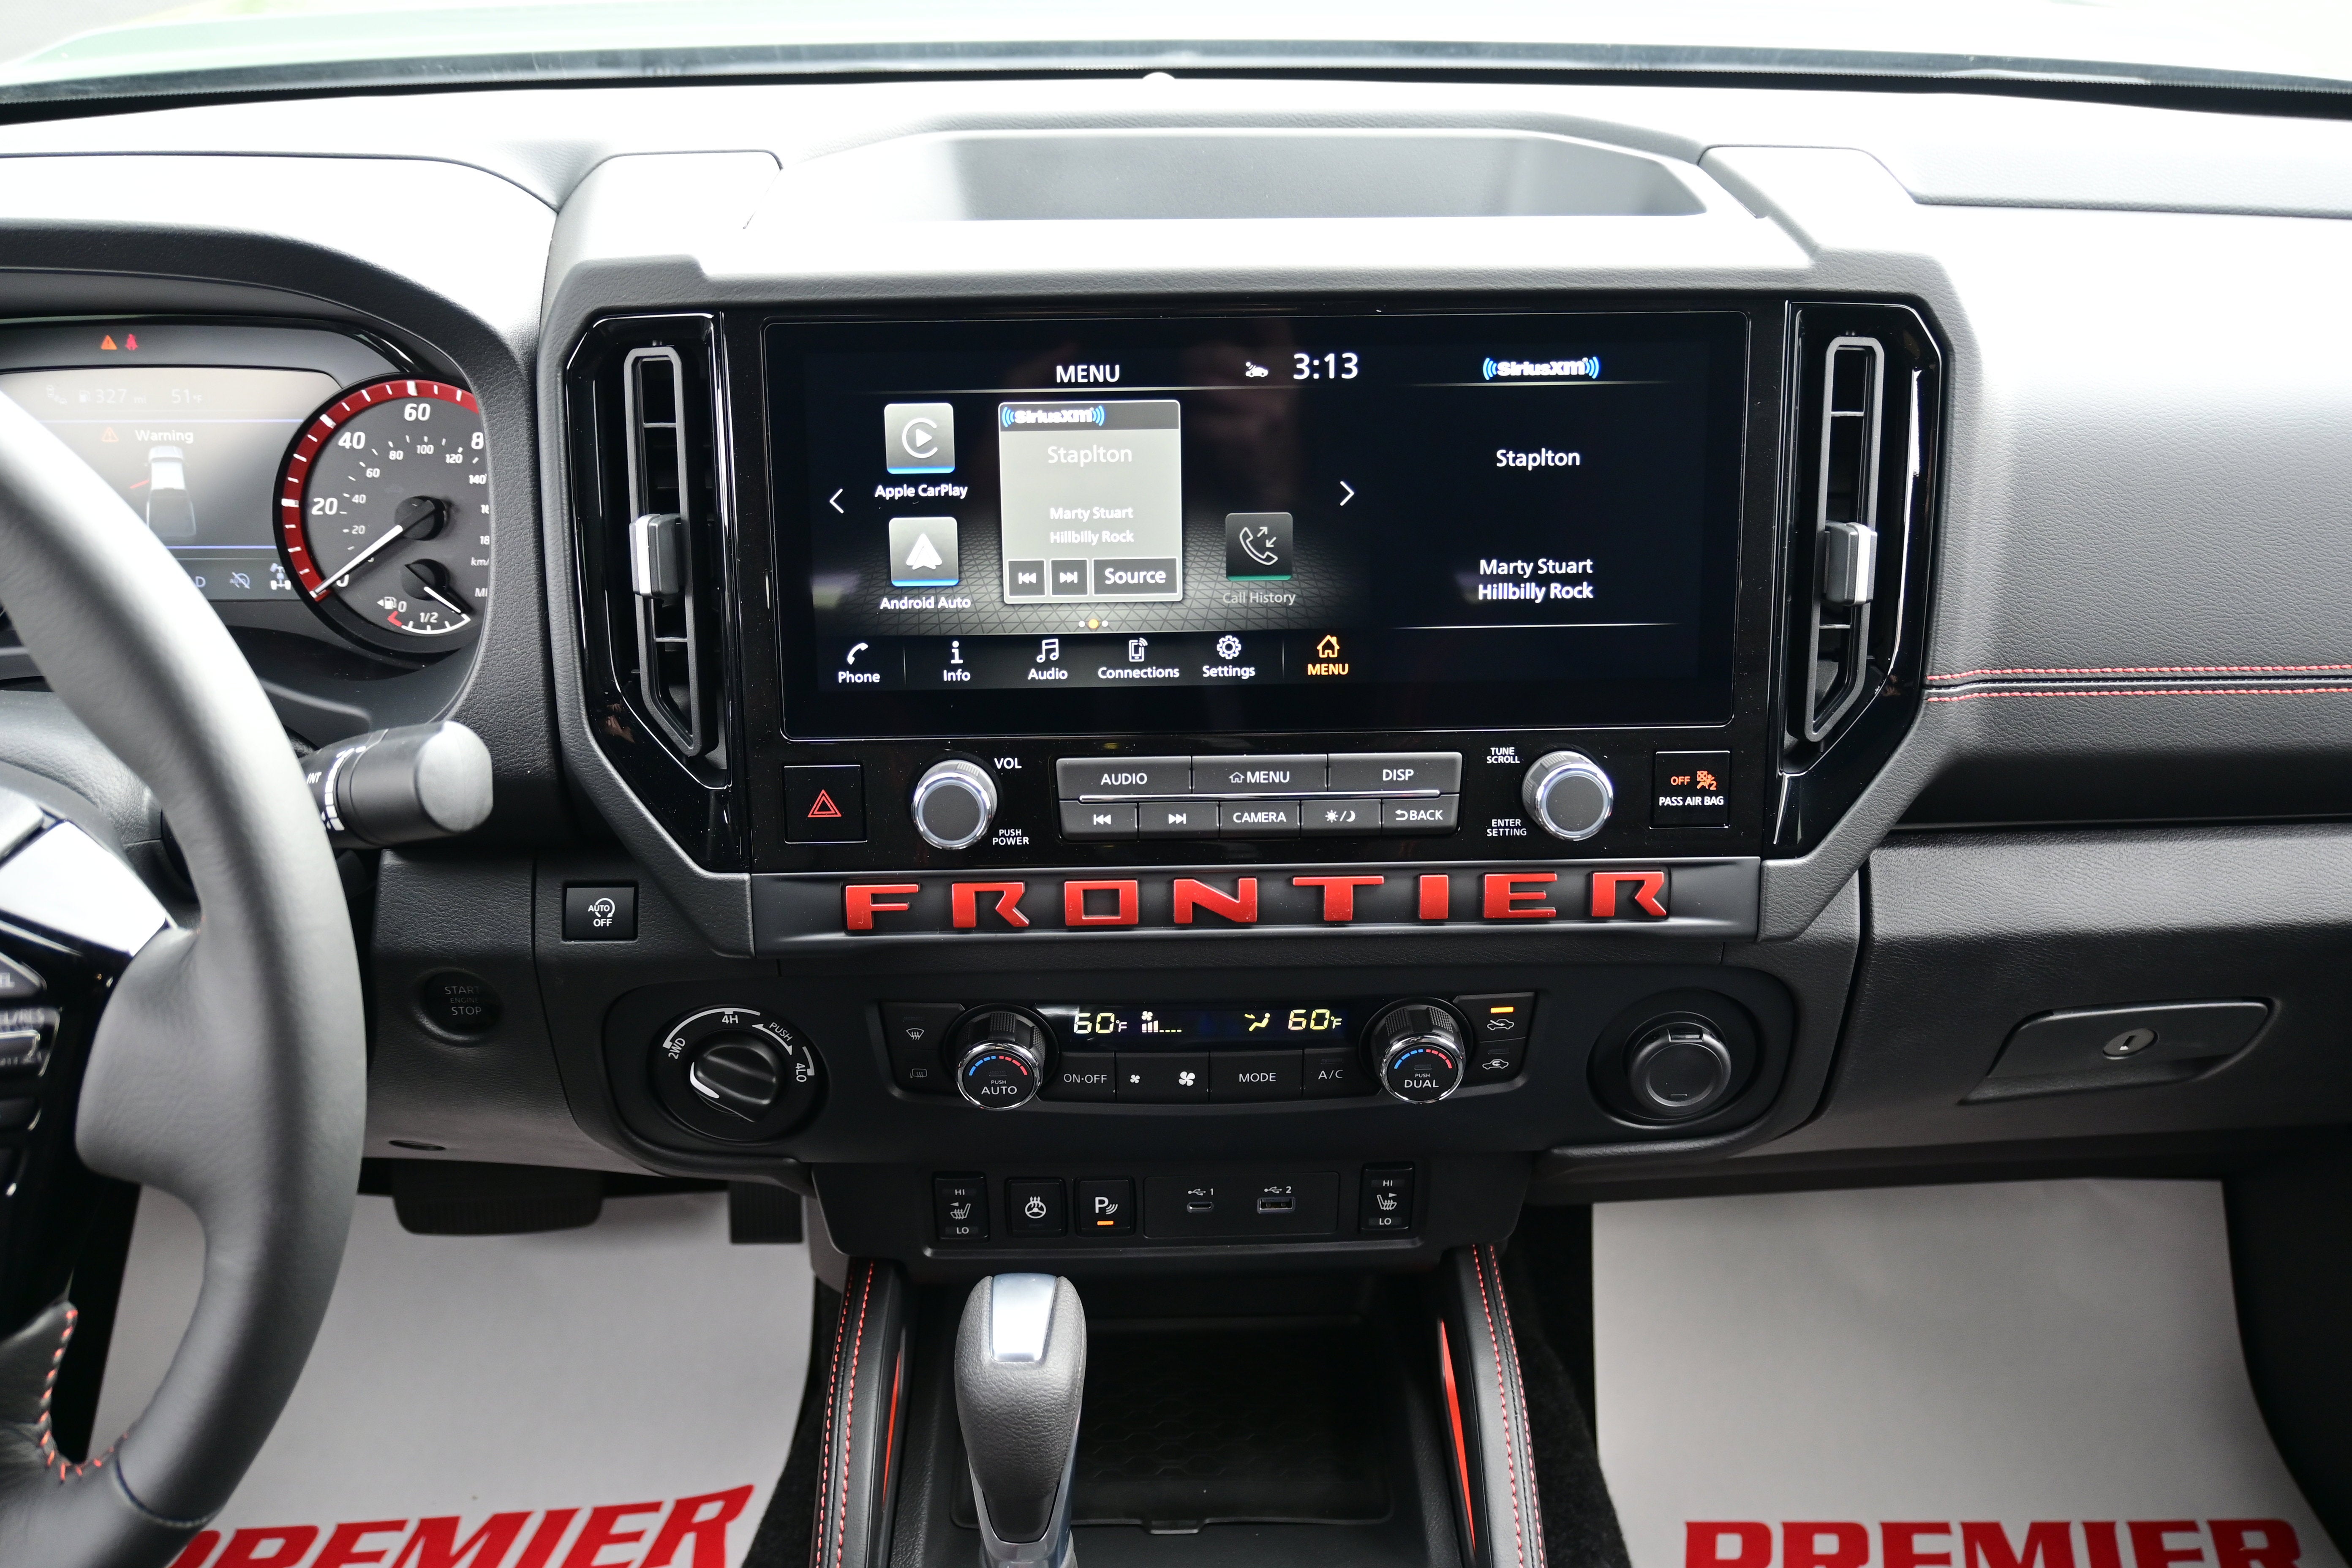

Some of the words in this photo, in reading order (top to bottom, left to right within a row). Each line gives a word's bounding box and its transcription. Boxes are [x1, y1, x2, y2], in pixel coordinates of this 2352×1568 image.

[1293, 352, 1358, 379] 3:13
[1056, 365, 1119, 382] MENU
[96, 389, 126, 403] 327
[404, 403, 430, 421] 60
[135, 430, 193, 444] Warning
[338, 432, 365, 449] 40
[471, 432, 484, 449] 8
[389, 451, 403, 460] 80
[417, 445, 434, 454] 100
[1048, 444, 1132, 467] Staplton
[446, 454, 463, 463] 120
[1497, 448, 1580, 471] Staplton
[366, 468, 380, 478] 60
[469, 474, 487, 484] 140
[875, 484, 915, 500] Apple
[918, 483, 968, 499] CarPlay
[352, 495, 366, 504] 40
[312, 498, 338, 514] 20
[1050, 507, 1090, 521] Marty
[1093, 507, 1133, 519] Stuart
[352, 525, 365, 534] 20
[480, 536, 490, 544] 18
[1050, 531, 1099, 545] Hillbilly
[1102, 530, 1134, 542] Rock
[471, 557, 489, 567] km/
[1480, 559, 1533, 578] Marty
[1538, 558, 1593, 574] Stuart
[1105, 568, 1166, 584] Source
[194, 576, 205, 589] D
[1221, 590, 1245, 603] Call
[1250, 590, 1296, 605] History
[1478, 583, 1546, 603] Hillbilly
[1550, 582, 1593, 599] Rock
[880, 596, 934, 609] Android
[938, 597, 971, 608] Auto
[420, 612, 438, 623] 1/2
[944, 669, 970, 681] Info
[1028, 667, 1067, 680] Audio
[1098, 667, 1179, 678] Connections
[1203, 665, 1255, 679] Settings
[1308, 664, 1348, 675] MENU
[838, 671, 880, 683] Phone
[1490, 747, 1514, 755] TUNE
[994, 758, 1022, 769] VOL
[307, 772, 322, 784] INT
[1101, 773, 1147, 785] AUDIO
[1247, 771, 1289, 783] MENU
[1383, 769, 1414, 781] DISP
[1671, 776, 1690, 785] OFF
[1659, 797, 1683, 806] PASS
[1685, 797, 1701, 805] AIR
[1704, 796, 1723, 805] BAG
[1233, 812, 1286, 822] CAMERA
[1410, 810, 1443, 820] BACK
[993, 837, 1029, 845] POWER
[846, 871, 1666, 929] FRONTIER
[445, 986, 478, 994] START
[452, 1007, 481, 1015] STOP
[722, 1015, 738, 1024] 4H
[769, 1021, 793, 1042] PUSH
[668, 1037, 686, 1059] 2WD
[795, 1063, 806, 1082] 4LO
[1239, 1073, 1276, 1082] MODE
[1318, 1070, 1342, 1079] A/C
[982, 1086, 1017, 1094] AUTO
[1405, 1080, 1439, 1088] DUAL
